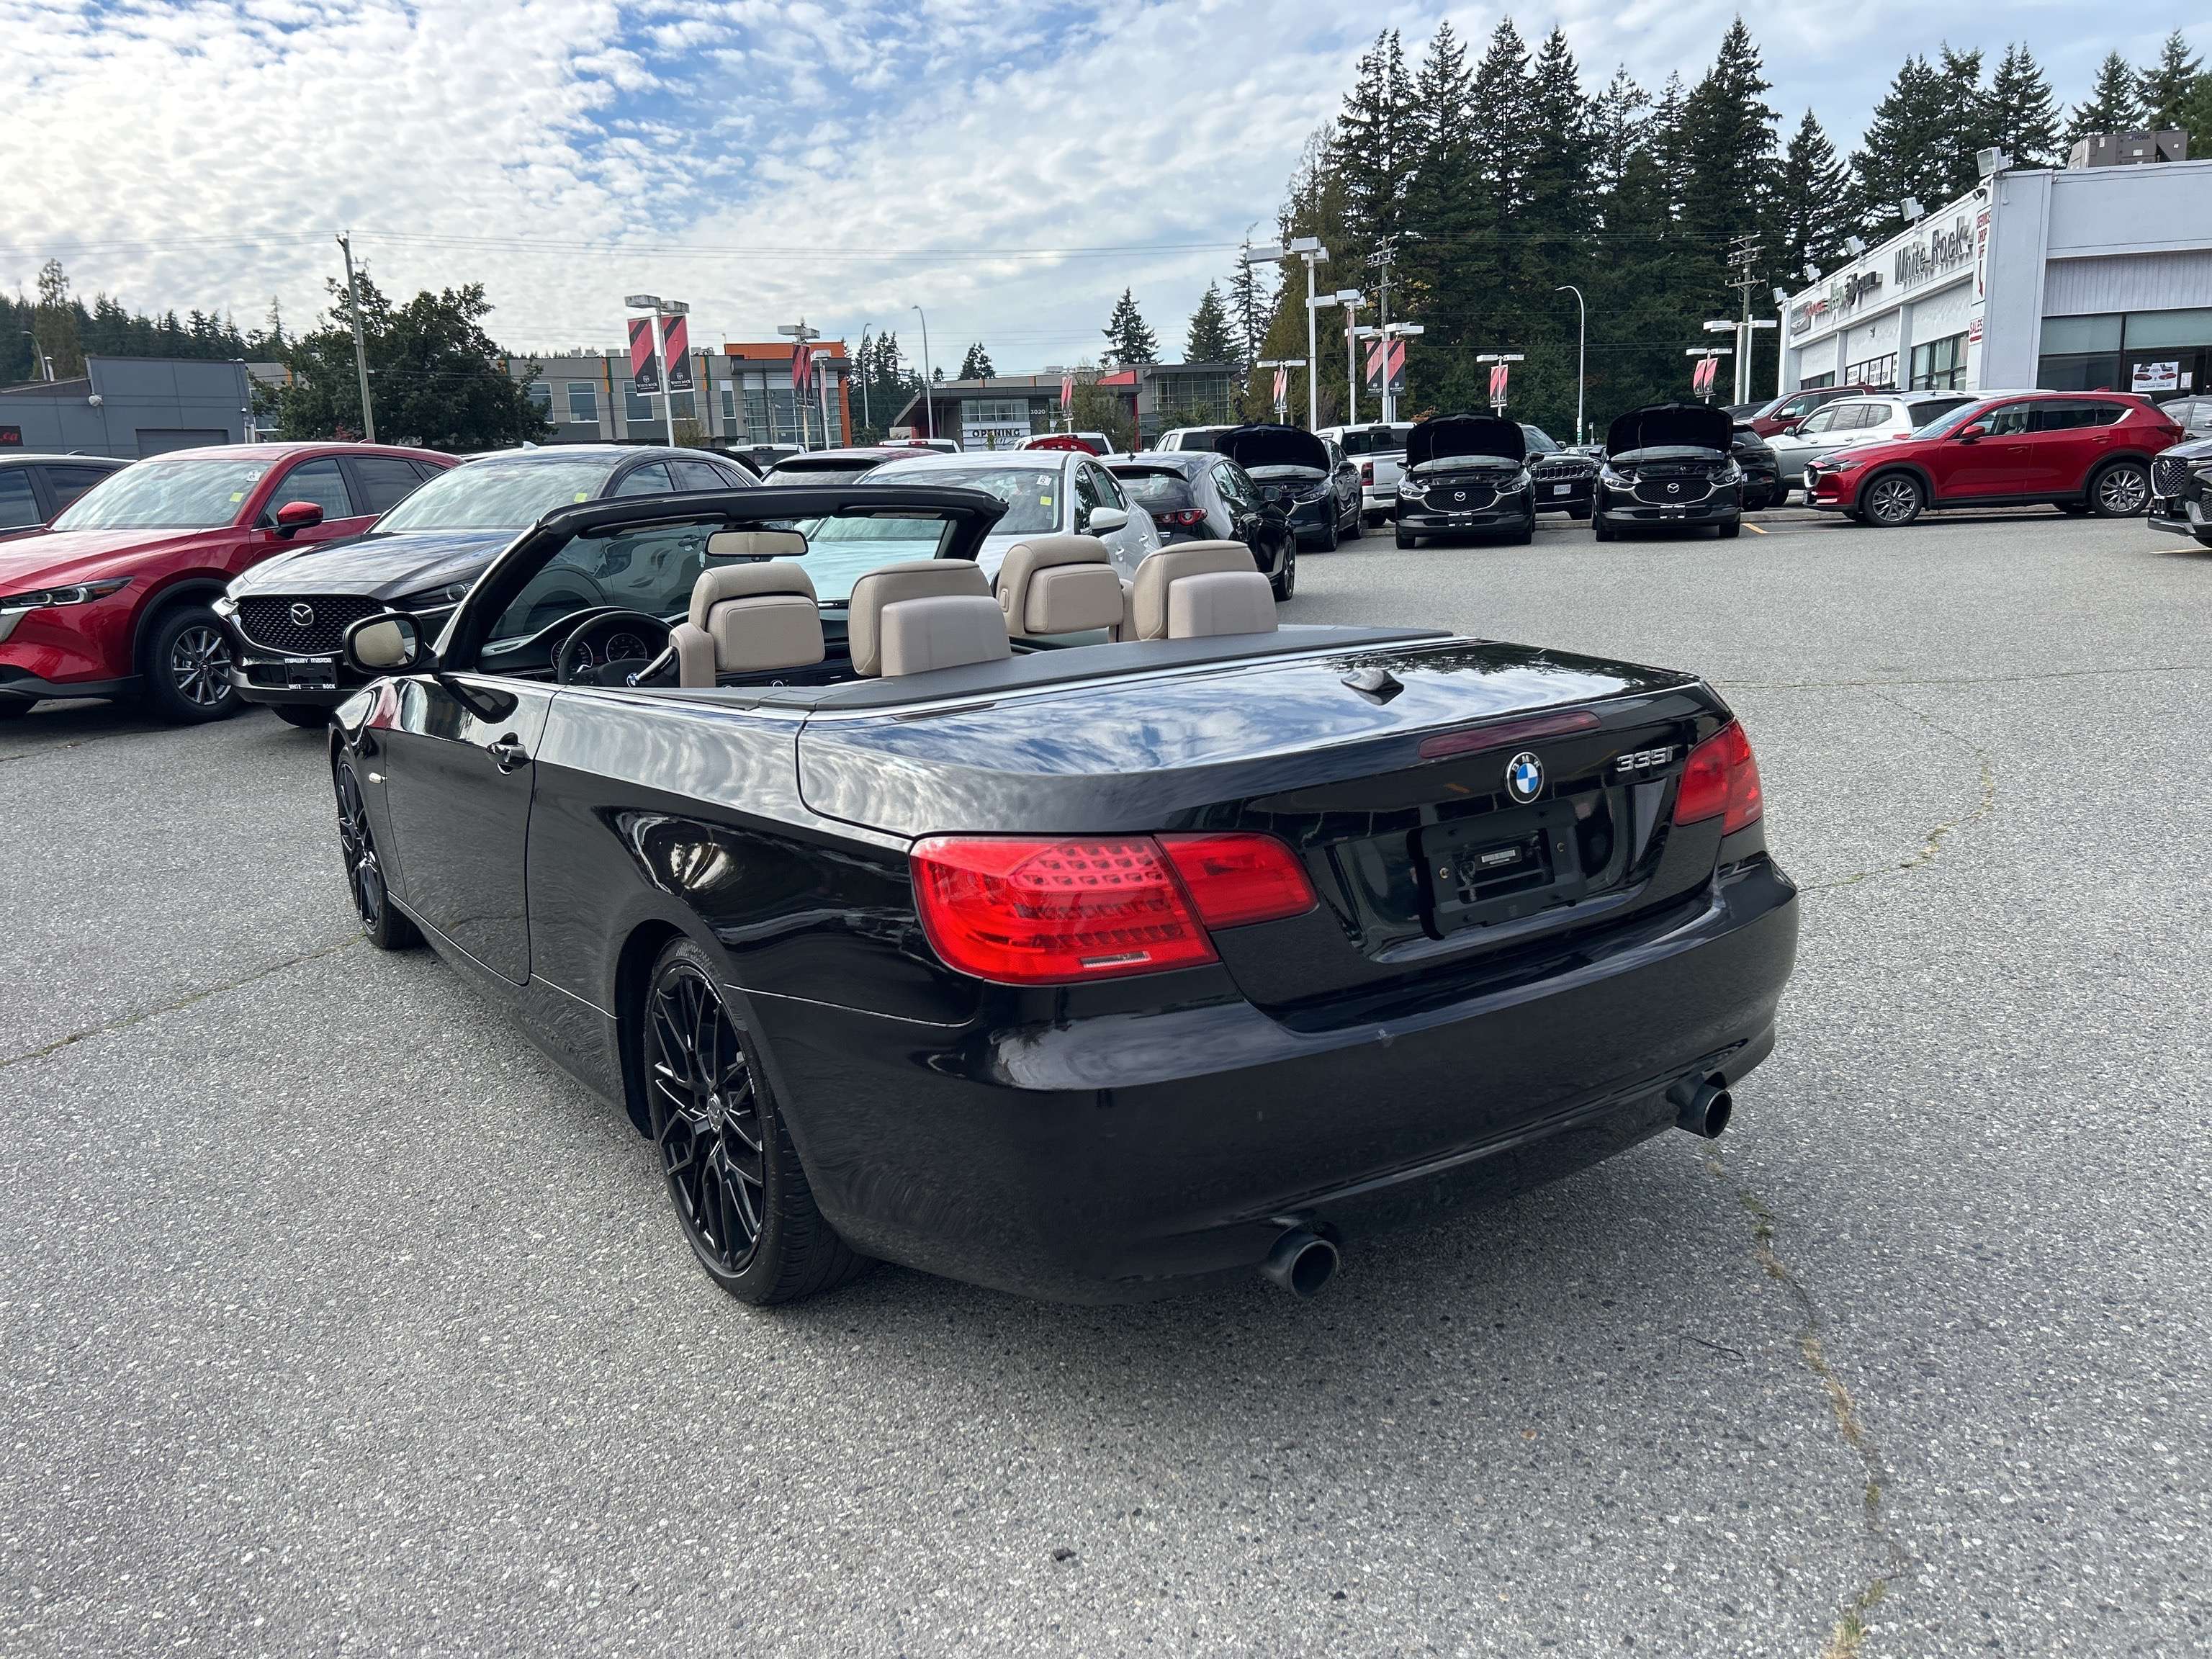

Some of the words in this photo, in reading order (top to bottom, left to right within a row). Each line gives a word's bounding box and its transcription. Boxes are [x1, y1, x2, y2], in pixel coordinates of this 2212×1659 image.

[1894, 242, 1928, 285] White
[1931, 216, 1966, 269] Rock
[1970, 318, 1983, 335] SALES
[1511, 755, 1540, 773] BMW
[1617, 746, 1673, 773] 335i
